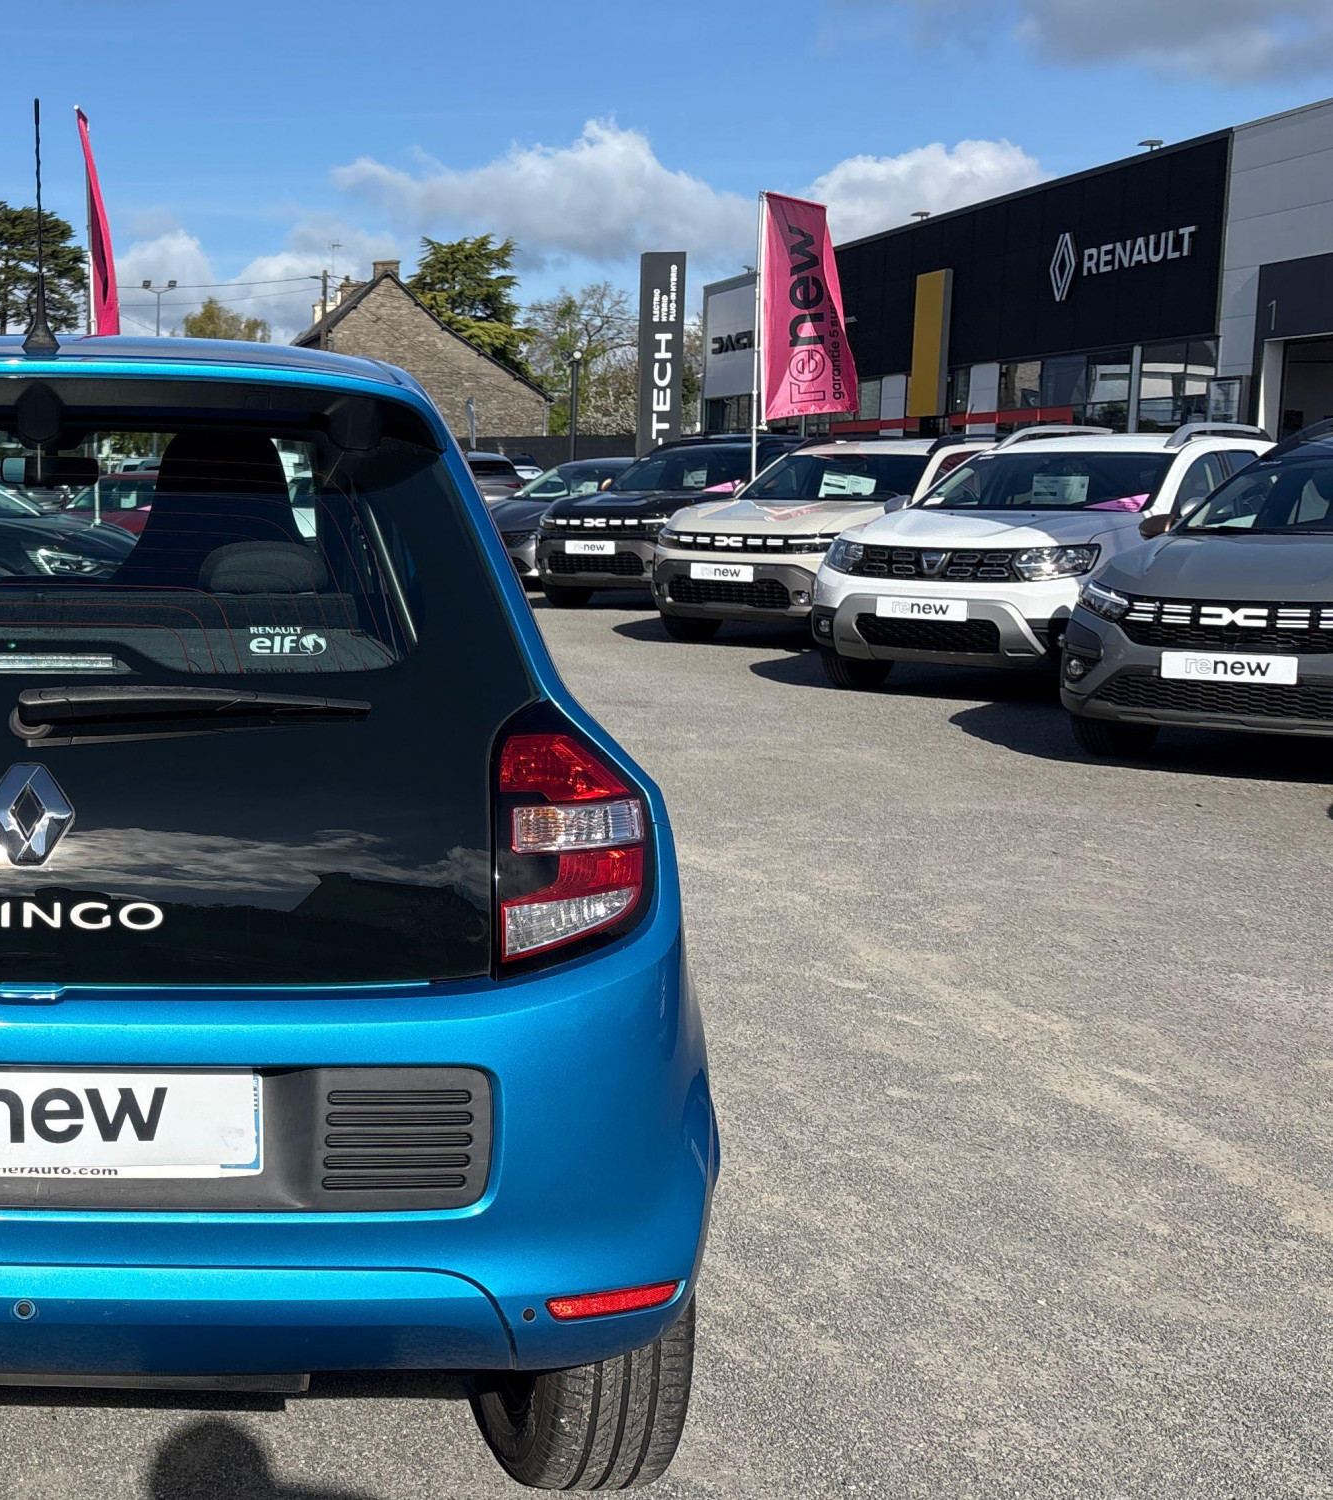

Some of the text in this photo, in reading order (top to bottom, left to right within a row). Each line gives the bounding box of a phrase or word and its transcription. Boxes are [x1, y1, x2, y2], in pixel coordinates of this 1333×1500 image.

[1082, 225, 1197, 277] RENAULT
[670, 264, 678, 291] HYBRID
[652, 288, 661, 323] ELECTRIC
[660, 294, 669, 323] HYBRID
[788, 224, 826, 404] renew
[1267, 299, 1277, 331] 1
[711, 330, 754, 354] DACI
[828, 329, 839, 338] 5
[829, 341, 845, 401] garantie
[701, 565, 741, 578] renew
[891, 600, 950, 616] renew
[249, 626, 302, 634] RENAULT
[249, 635, 298, 654] elf
[1184, 652, 1271, 677] renew
